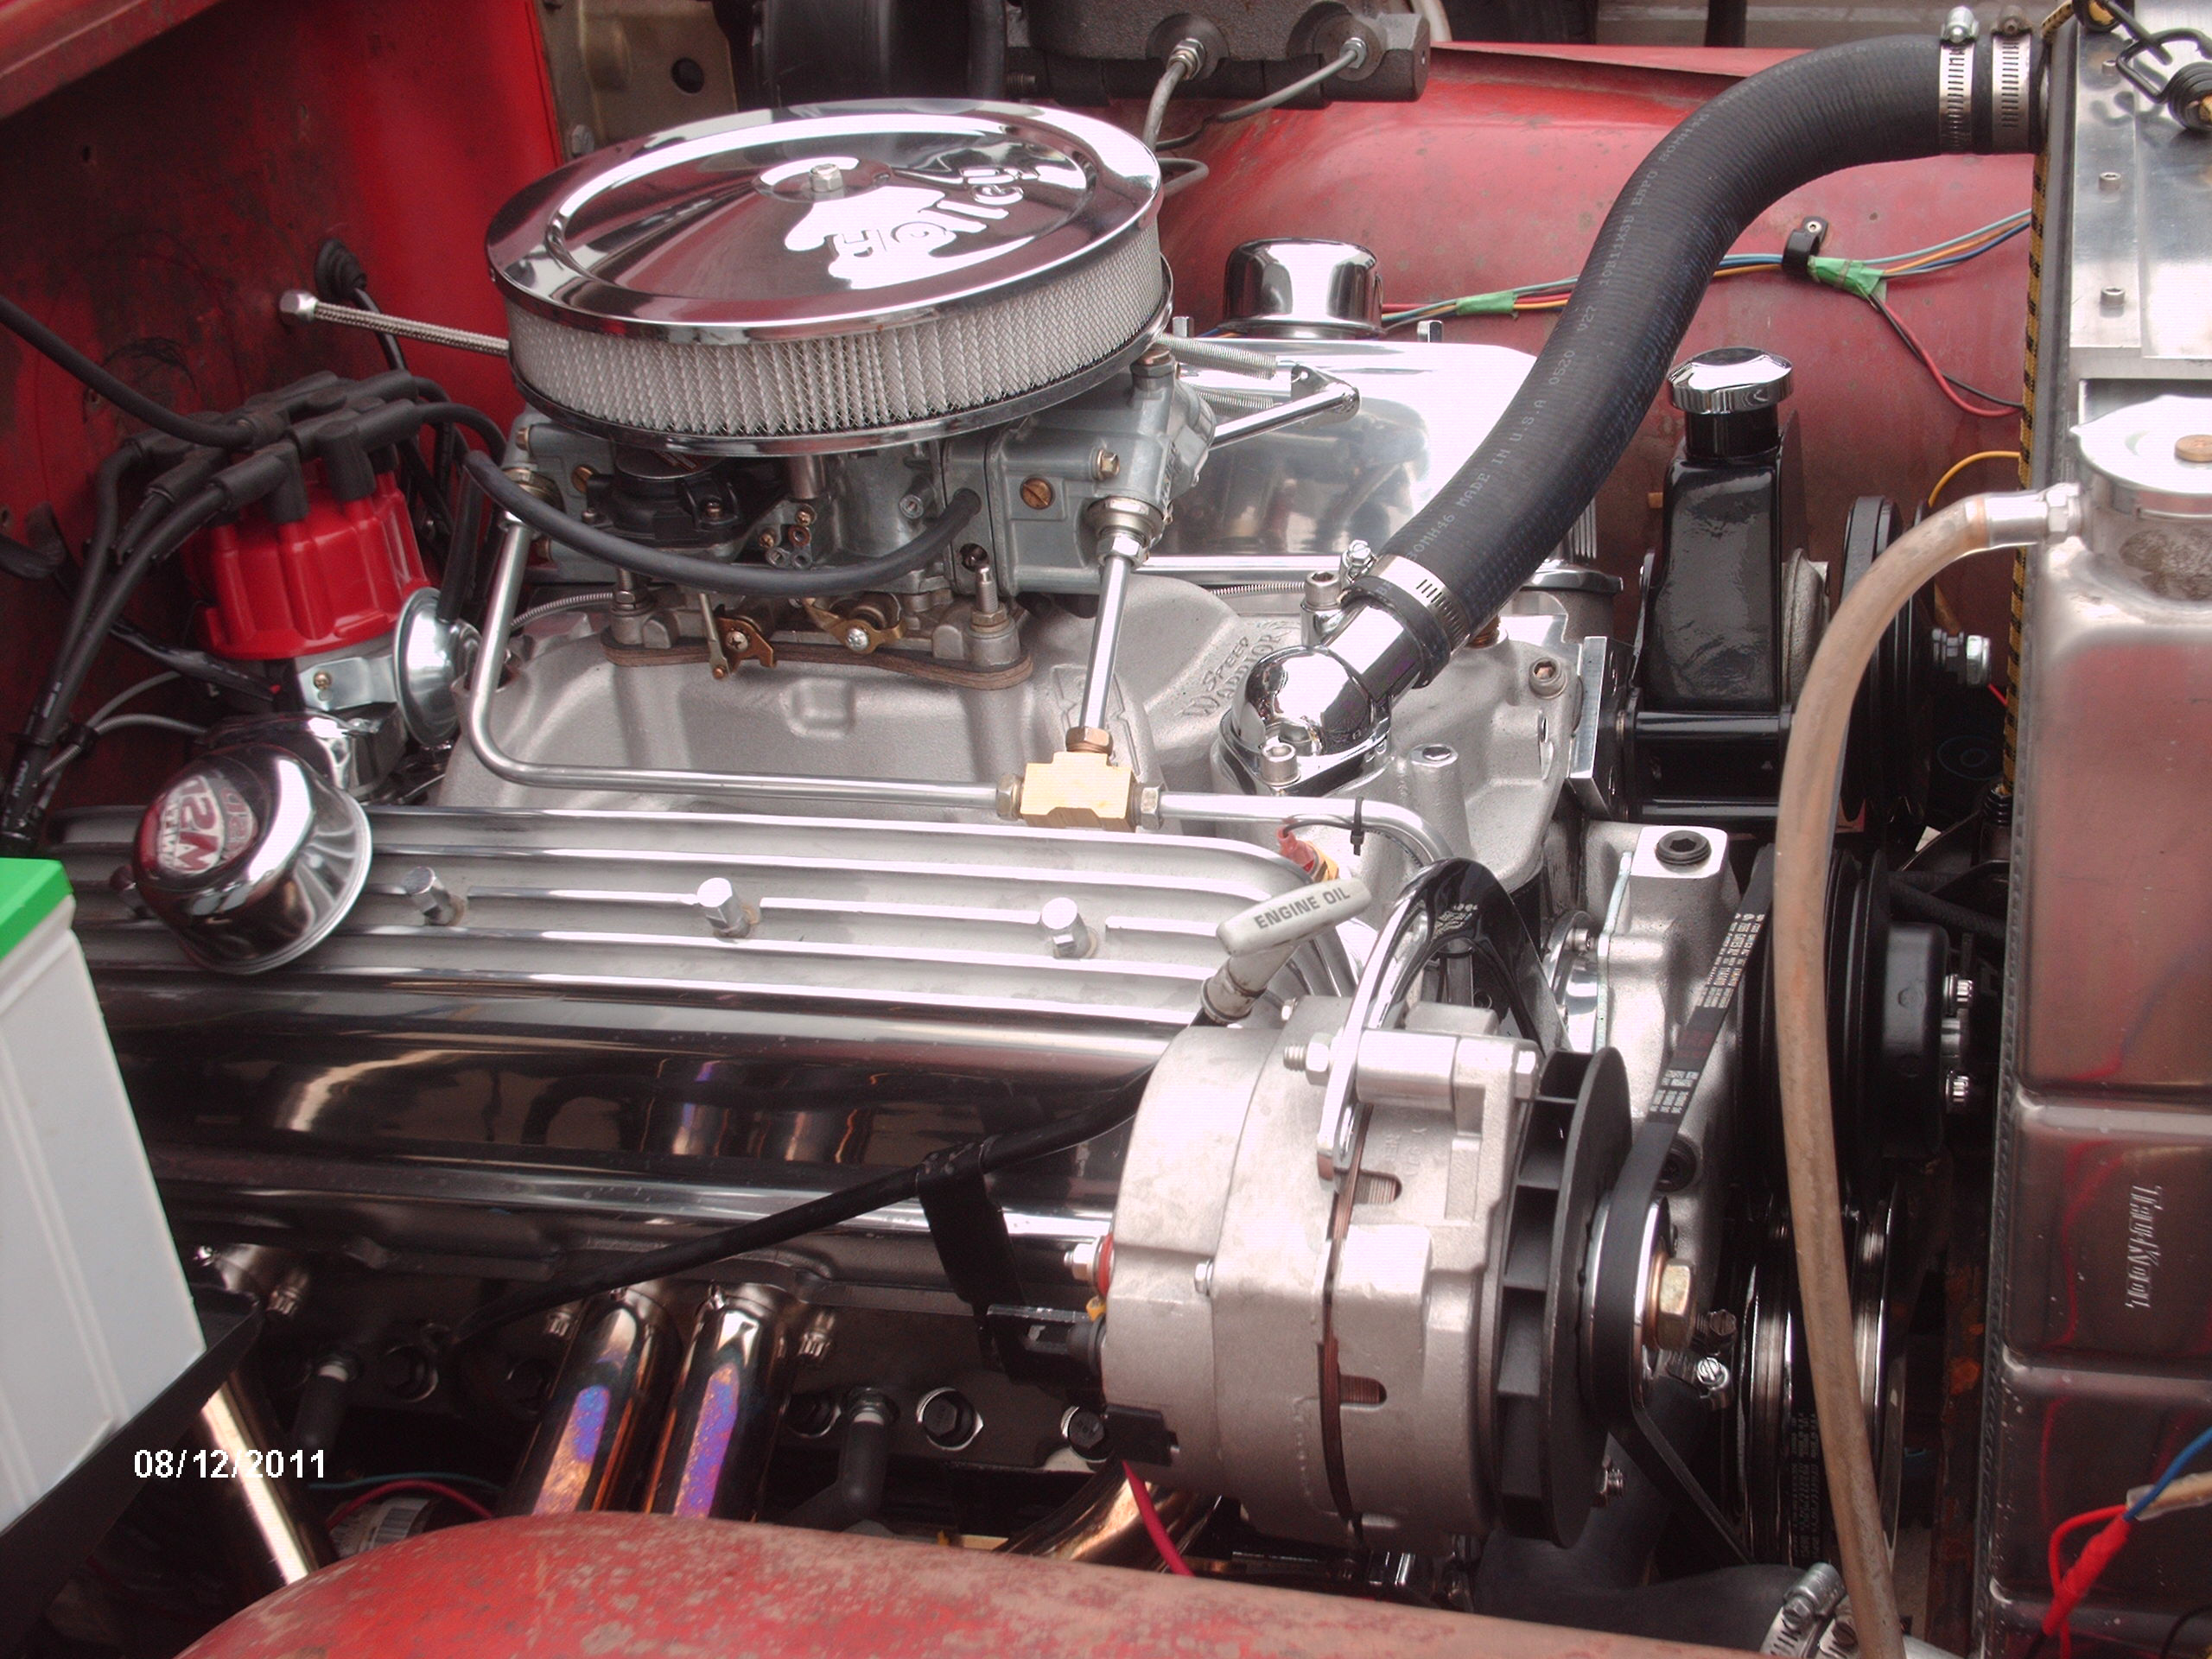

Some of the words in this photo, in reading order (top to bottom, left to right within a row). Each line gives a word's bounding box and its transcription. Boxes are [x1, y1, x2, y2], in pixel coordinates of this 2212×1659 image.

[1456, 473, 1491, 508] MADE
[1202, 636, 1249, 692] SPEED
[1253, 896, 1320, 929] ENGINE
[1323, 887, 1351, 905] OIL
